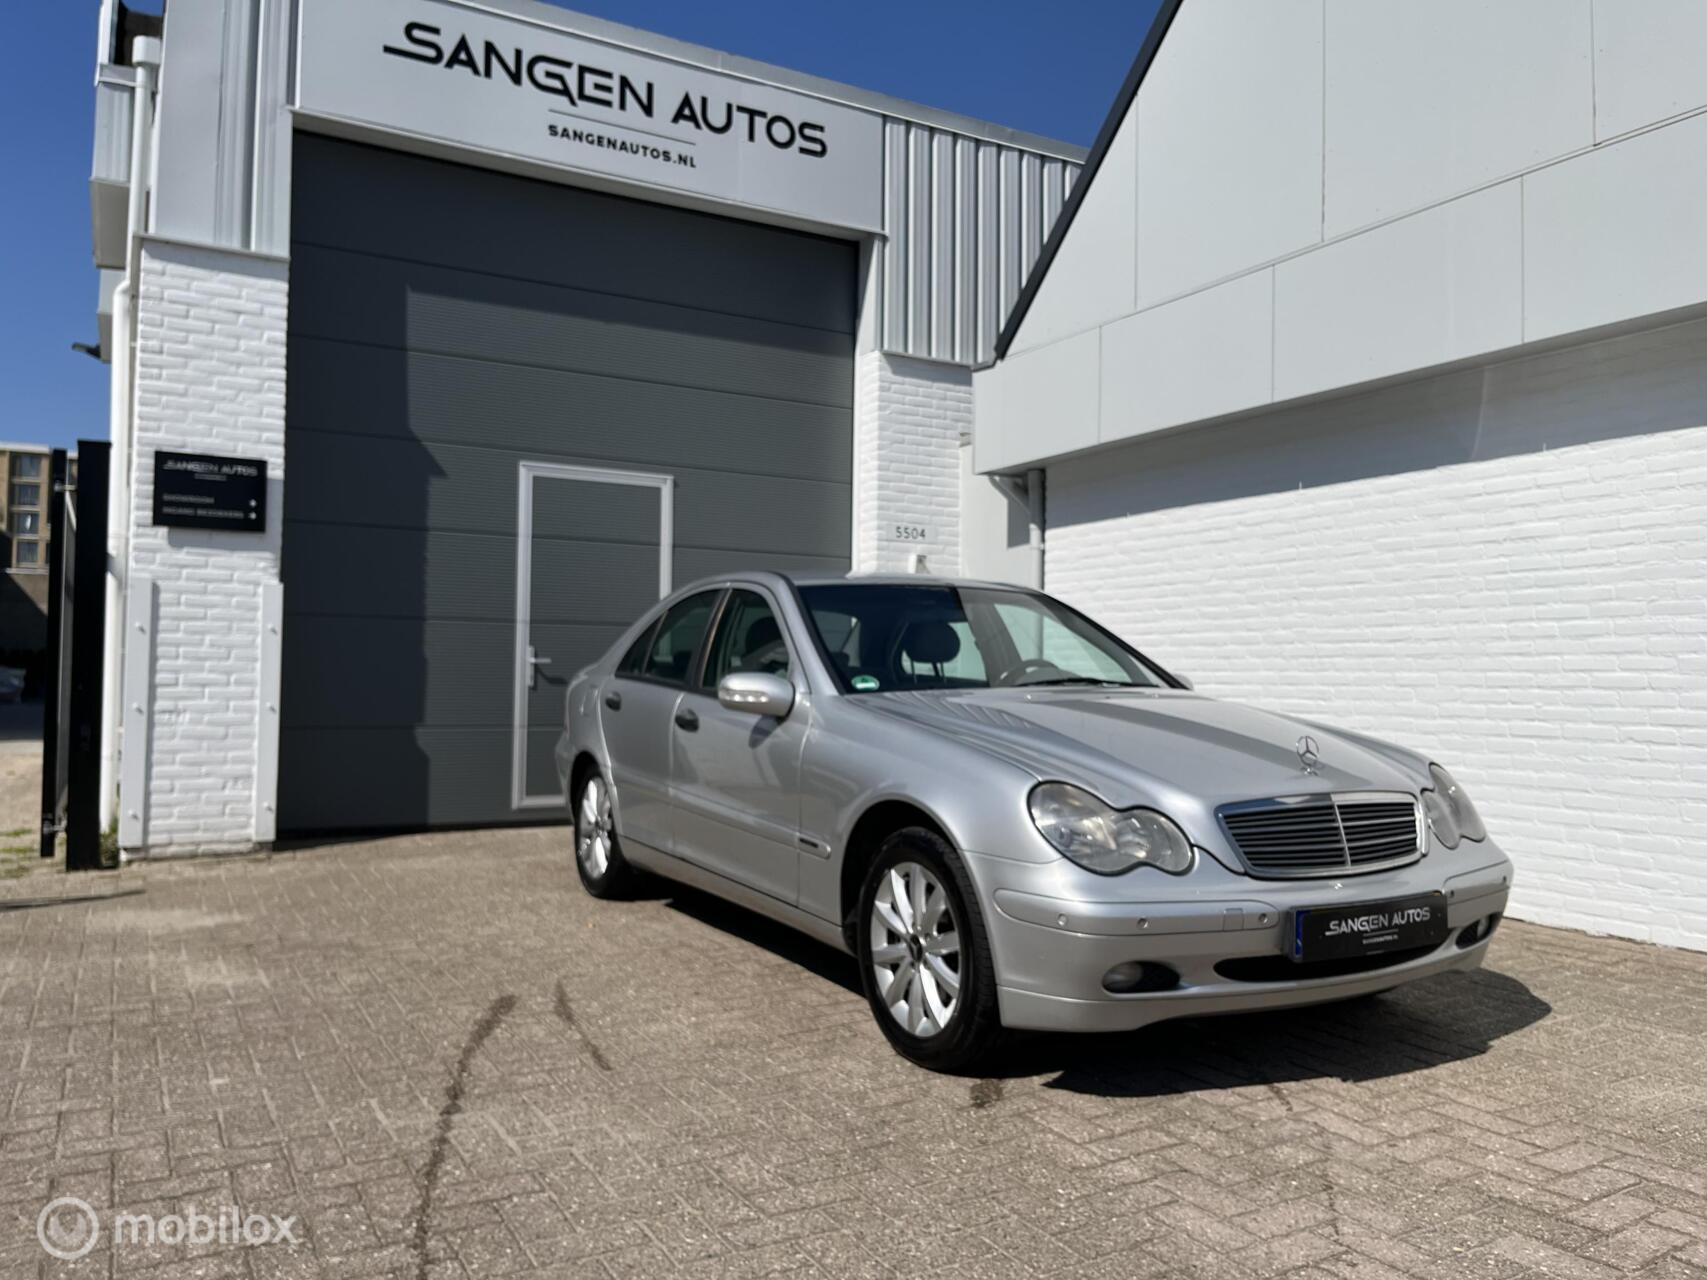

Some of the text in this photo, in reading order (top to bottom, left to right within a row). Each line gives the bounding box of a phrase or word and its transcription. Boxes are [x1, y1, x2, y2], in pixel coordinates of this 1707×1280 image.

[383, 22, 827, 158] SANGEN AUTOS
[548, 124, 697, 168] SANGENAUTOS.NL
[1325, 907, 1431, 936] SANGEN AUTOS
